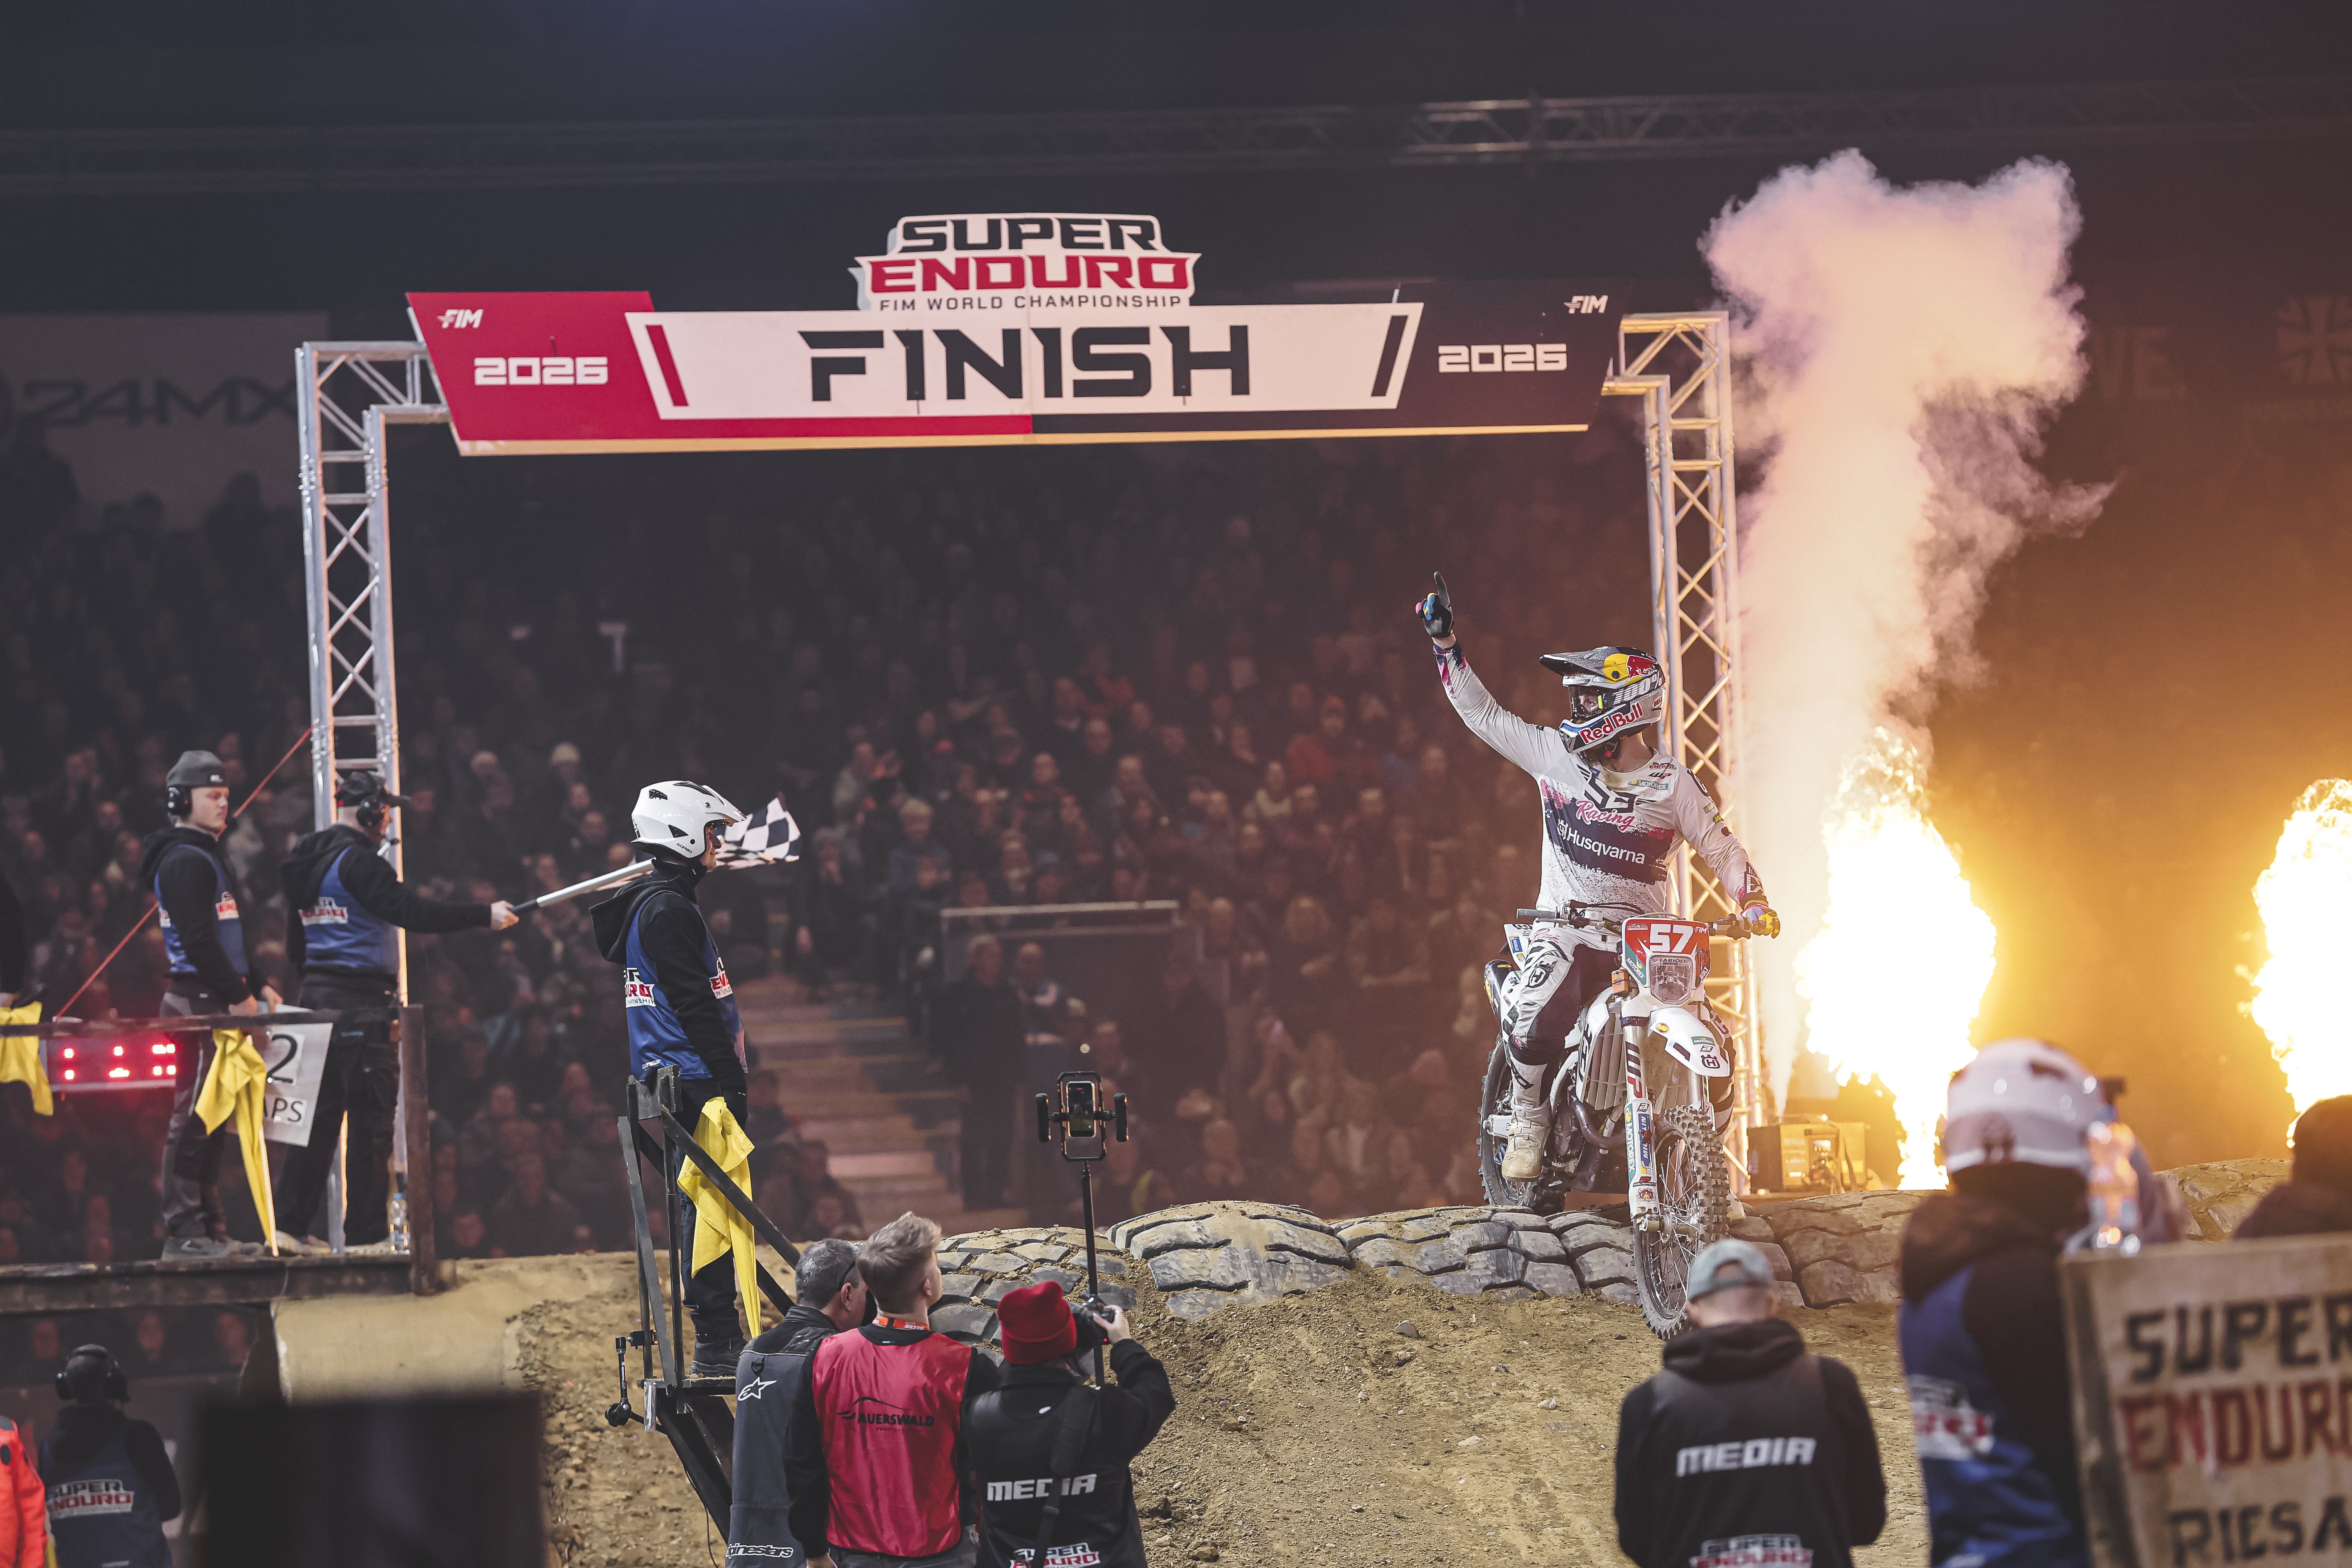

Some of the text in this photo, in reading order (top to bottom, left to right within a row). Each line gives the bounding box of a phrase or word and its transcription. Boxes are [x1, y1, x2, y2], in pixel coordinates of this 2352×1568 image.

[897, 218, 1166, 253] SUPER
[869, 255, 1188, 292] ENDURO
[880, 296, 1181, 310] FIM WORLD CHAMPIONSHIP
[1564, 295, 1608, 314] FIM
[437, 309, 483, 329] FIM
[474, 356, 608, 386] 2026
[797, 325, 1250, 401] FINISH
[1438, 343, 1567, 373] 2026
[1579, 702, 1644, 744] Red Bull
[1638, 780, 1666, 789] MOTOREX
[1575, 800, 1636, 832] Racing
[1568, 826, 1645, 864] Husqvarna
[1650, 923, 1694, 953] 57
[1626, 958, 1645, 980] MOTOREX
[1699, 966, 1709, 980] BOLT
[267, 1034, 297, 1084] 2
[264, 1098, 303, 1122] PS
[1626, 1122, 1635, 1173] MOTOREX
[2126, 1296, 2352, 1384] SUPER
[858, 1413, 935, 1426] AUERSWALD
[1676, 1436, 1817, 1477] MEDIA
[2168, 1497, 2352, 1566] RIESA
